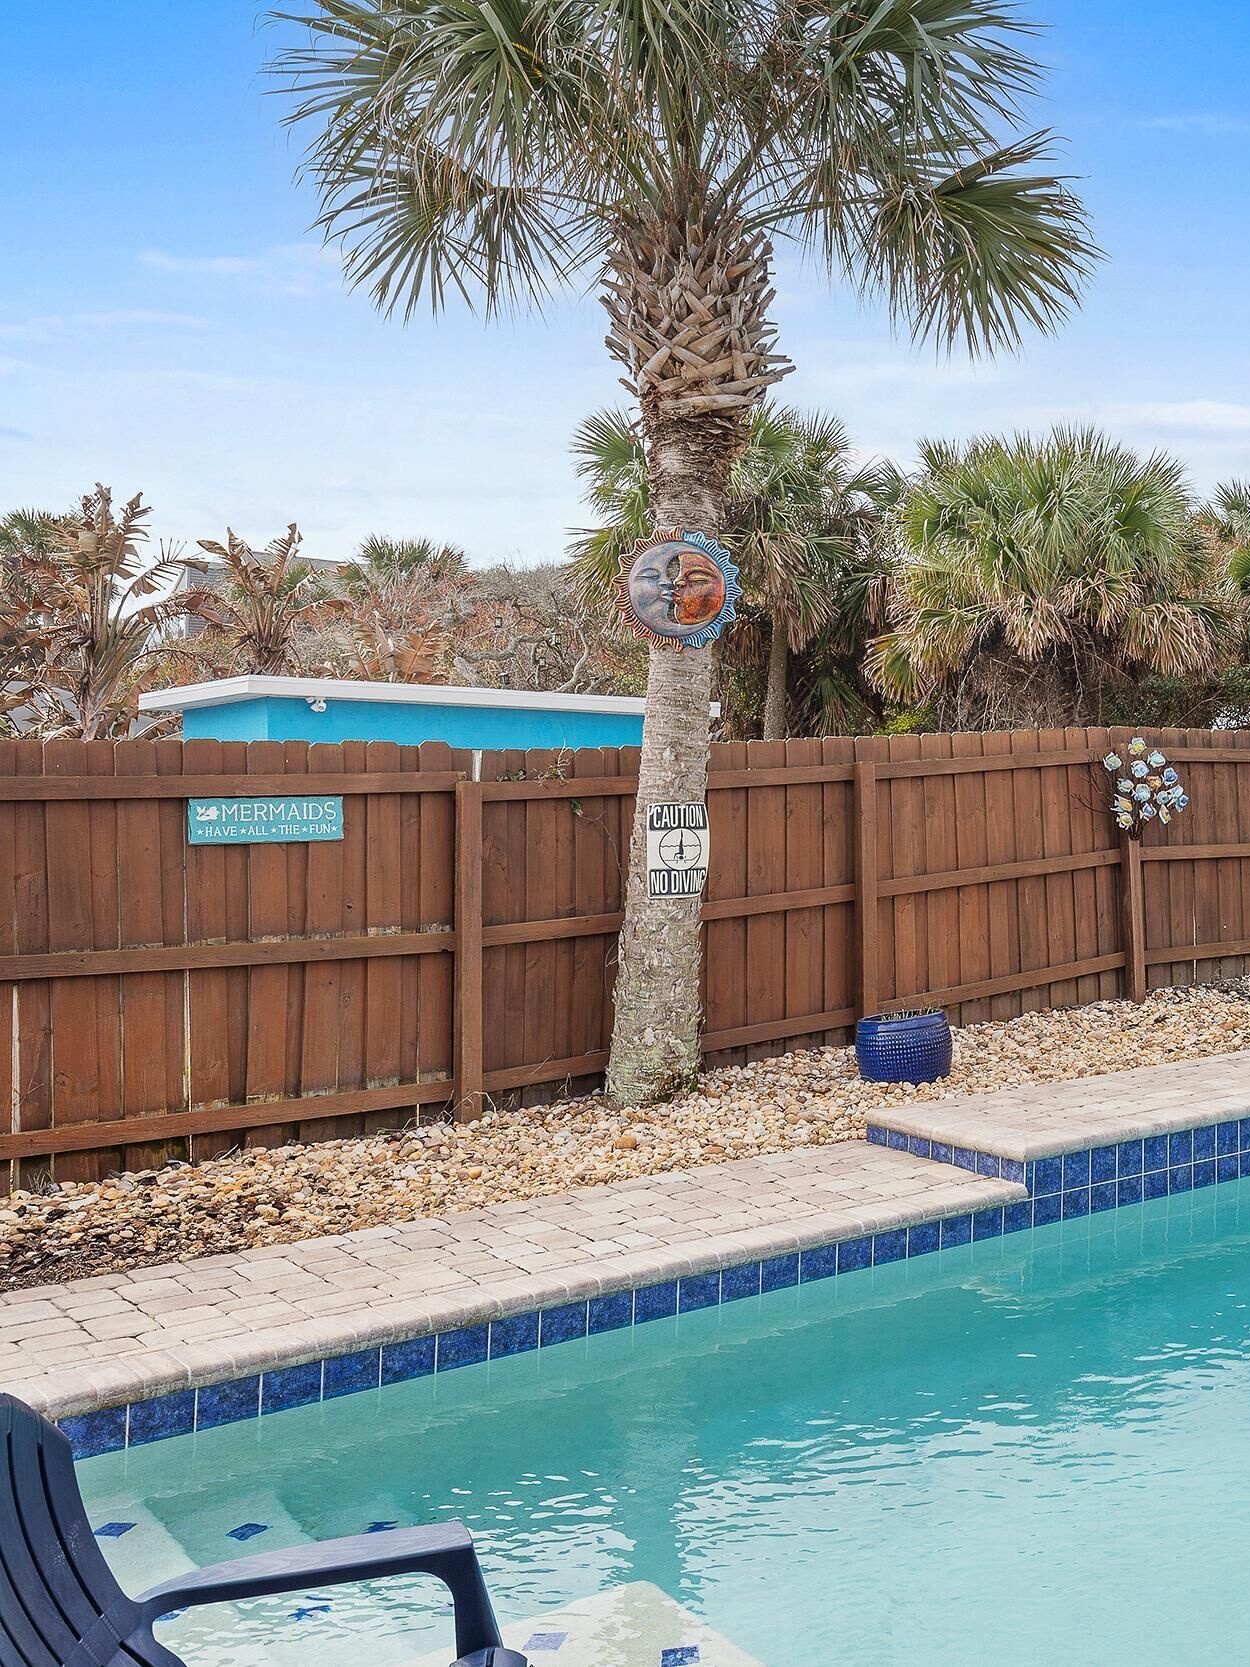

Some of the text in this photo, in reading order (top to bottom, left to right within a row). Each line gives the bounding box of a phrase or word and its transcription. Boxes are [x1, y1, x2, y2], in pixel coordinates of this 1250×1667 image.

[221, 801, 337, 822] MERMAIDS
[653, 804, 704, 828] CAUTION
[205, 823, 332, 837] HAVE ALL THE FUN
[650, 869, 706, 894] NO DIVING
